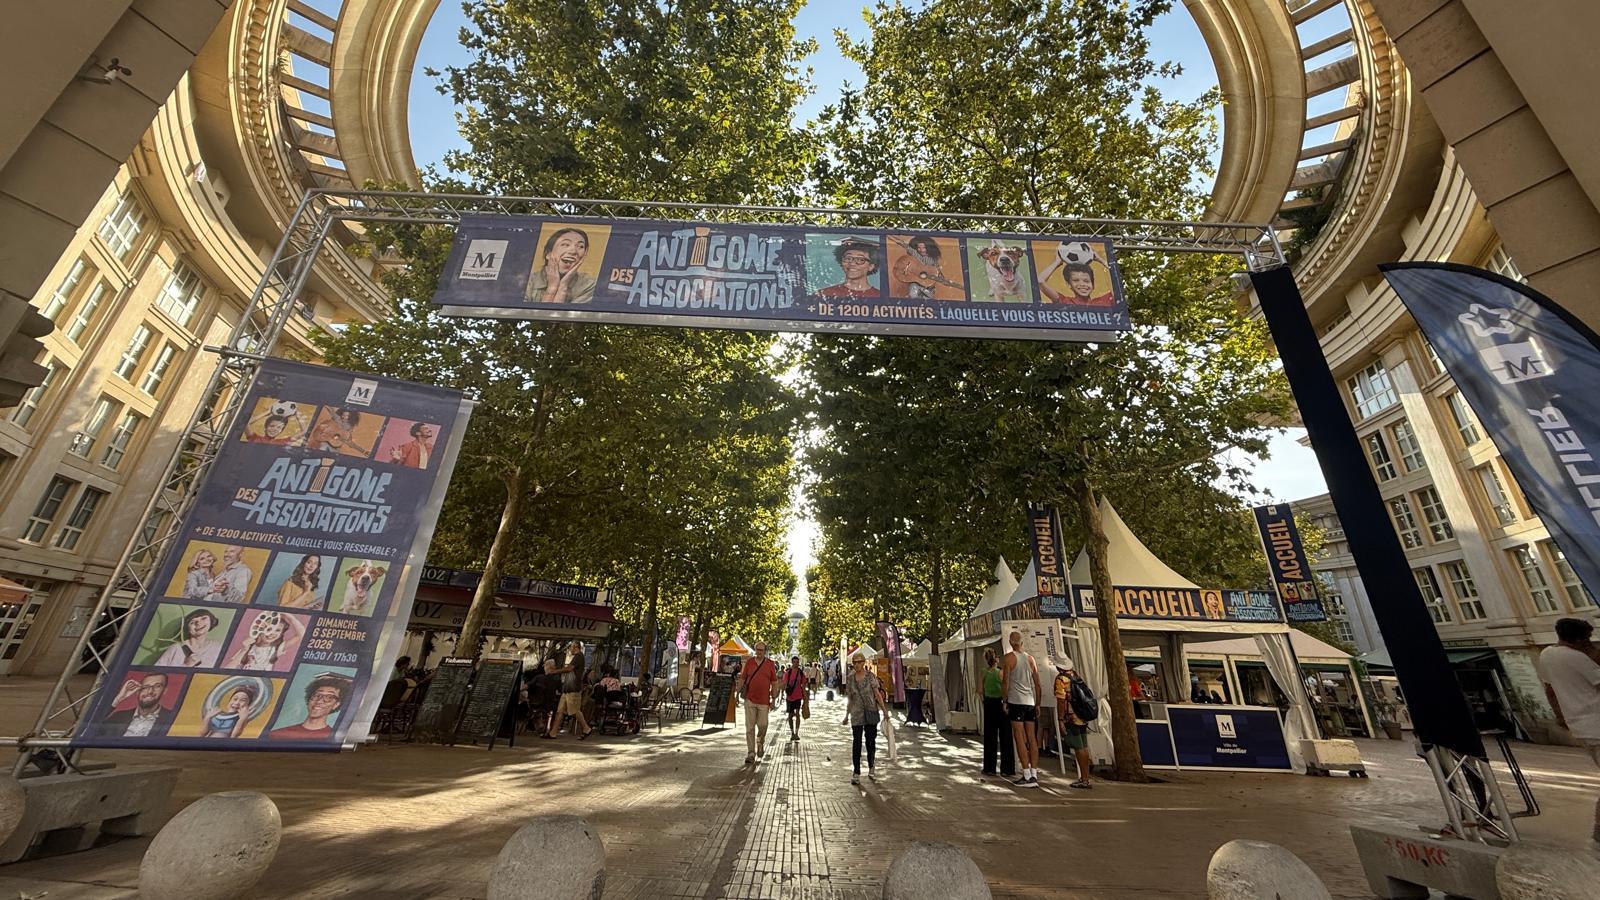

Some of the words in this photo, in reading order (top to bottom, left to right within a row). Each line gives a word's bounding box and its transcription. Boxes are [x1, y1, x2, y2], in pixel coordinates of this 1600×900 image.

[631, 227, 783, 276] ANTIGONE
[470, 252, 496, 269] M
[461, 271, 497, 279] Montpellier
[610, 267, 634, 284] DES
[627, 269, 794, 311] ASSOCIATIONS
[818, 302, 834, 316] DE
[837, 304, 870, 317] 1200
[872, 303, 938, 319] ACTIVITÉS.
[939, 307, 999, 322] LAQUELLE
[1001, 308, 1035, 323] VOUS
[1038, 309, 1112, 326] RESSEMBLE
[1113, 312, 1122, 326] ?
[353, 386, 370, 398] M
[258, 457, 393, 503] ANTIGONE
[236, 487, 259, 503] DES
[245, 490, 392, 534] ASSOCIATIONS
[202, 526, 215, 536] DE
[216, 528, 240, 539] 1200
[239, 531, 284, 545] ACTIVITÉS.
[285, 536, 322, 549] LAQUELLE
[323, 539, 348, 550] VOUS
[344, 542, 391, 556] RESSEMBLE
[390, 548, 397, 556] ?
[1034, 515, 1057, 575] ACCUEIL
[1267, 518, 1304, 580] ACCUEIL
[535, 583, 597, 600] RESTAURANT
[1229, 590, 1272, 607] ANTIGONE
[1085, 596, 1095, 607] M
[1114, 589, 1200, 617] ACCUEIL
[316, 617, 358, 630] DIMANCHE
[312, 627, 320, 638] 6
[320, 628, 367, 641] SEPTEMBRE
[307, 639, 333, 650] 2026
[303, 650, 326, 660] 9h30
[327, 651, 333, 661] /
[333, 652, 358, 662] 17h30
[1221, 722, 1232, 731] M
